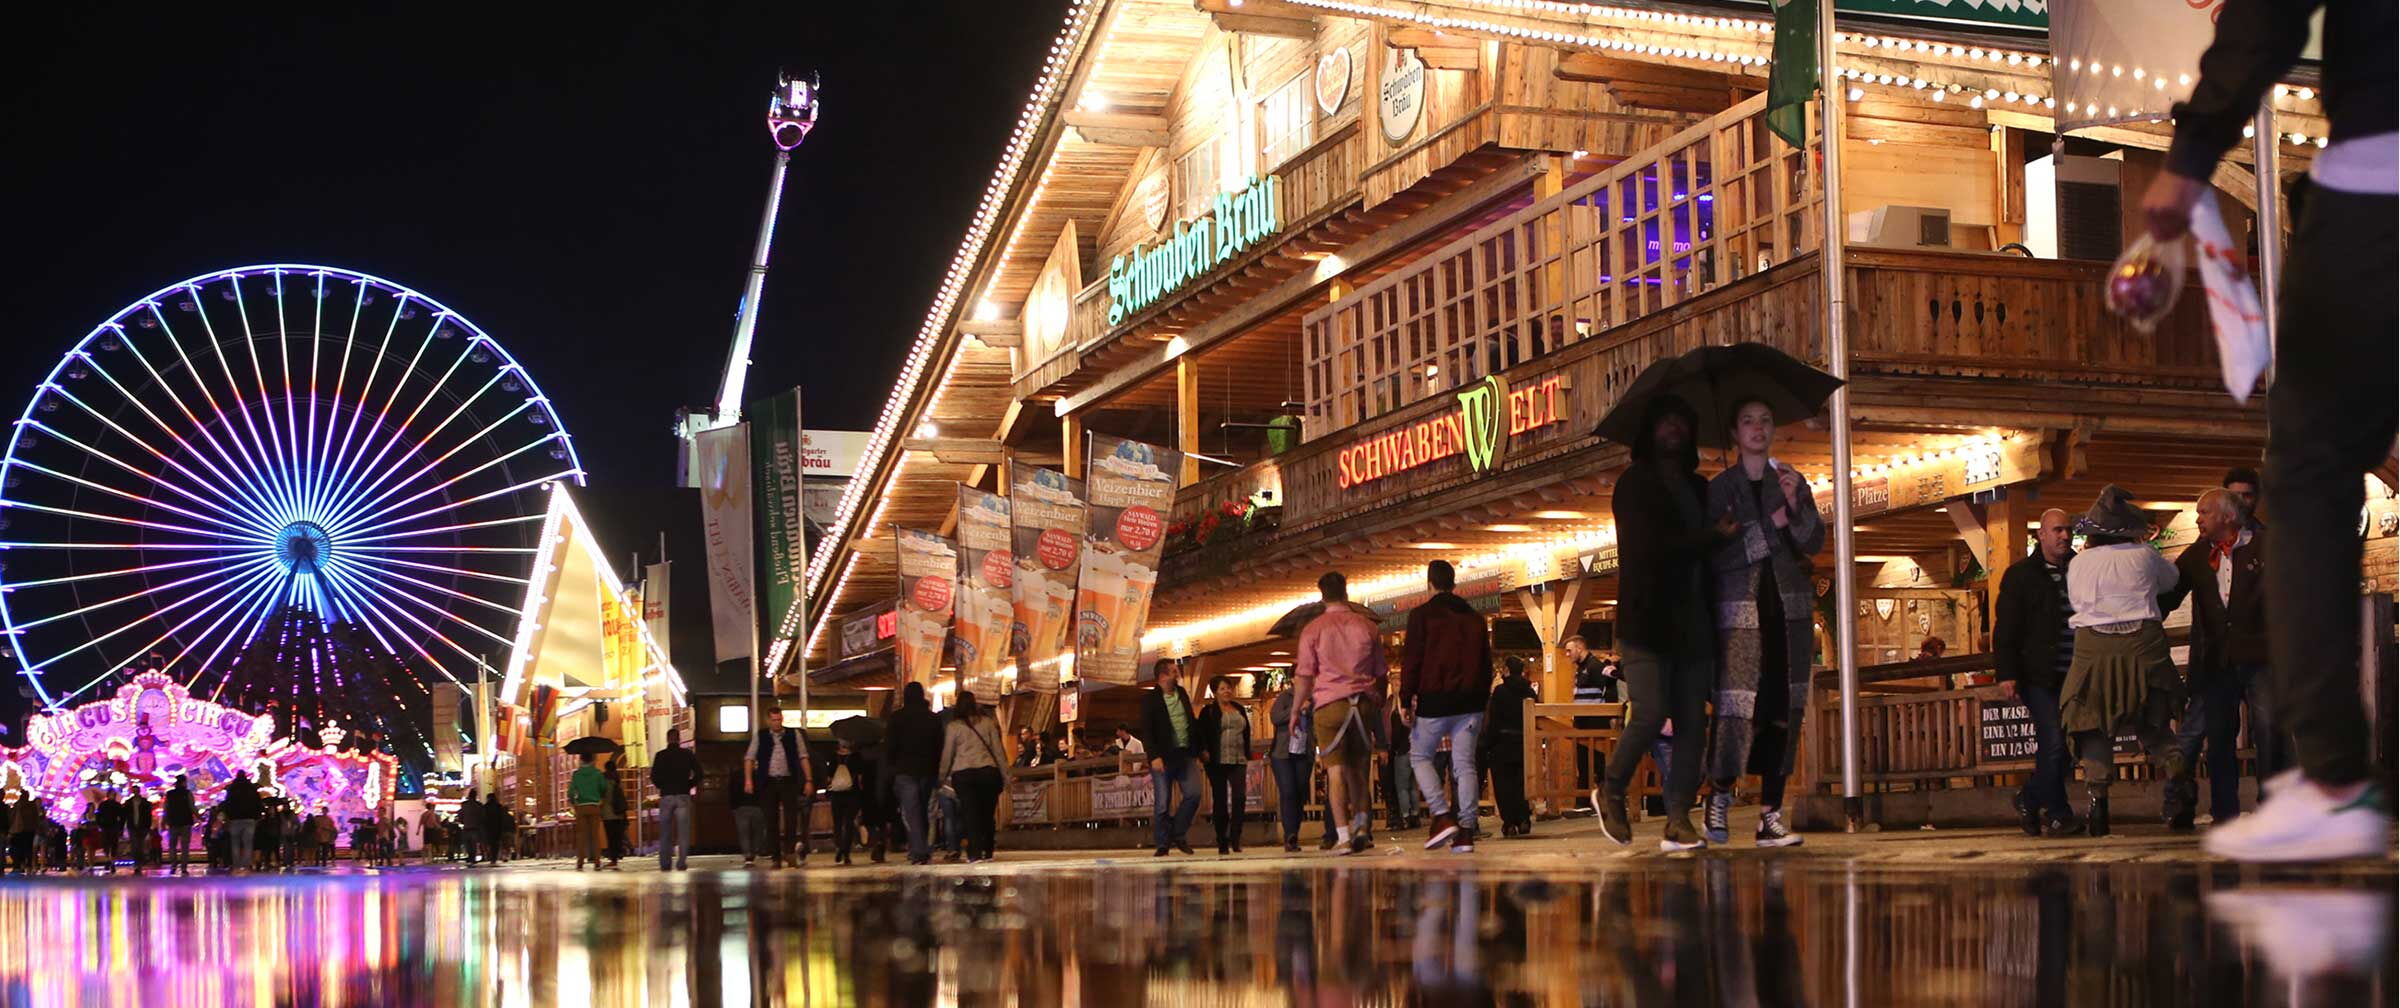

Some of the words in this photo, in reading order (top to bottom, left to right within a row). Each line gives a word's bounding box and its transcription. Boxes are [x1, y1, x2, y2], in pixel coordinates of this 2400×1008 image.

[1383, 66, 1421, 104] Schwaben
[1392, 92, 1411, 118] Bräu
[1109, 217, 1212, 326] Schwaben
[1213, 172, 1279, 265] Bräu
[1857, 486, 1888, 507] Plätze
[39, 701, 127, 748] CIRCUS
[1983, 708, 2000, 721] DER
[1983, 725, 2005, 739] EINE
[1991, 743, 2007, 757] EIN
[2010, 741, 2022, 757] 1/2
